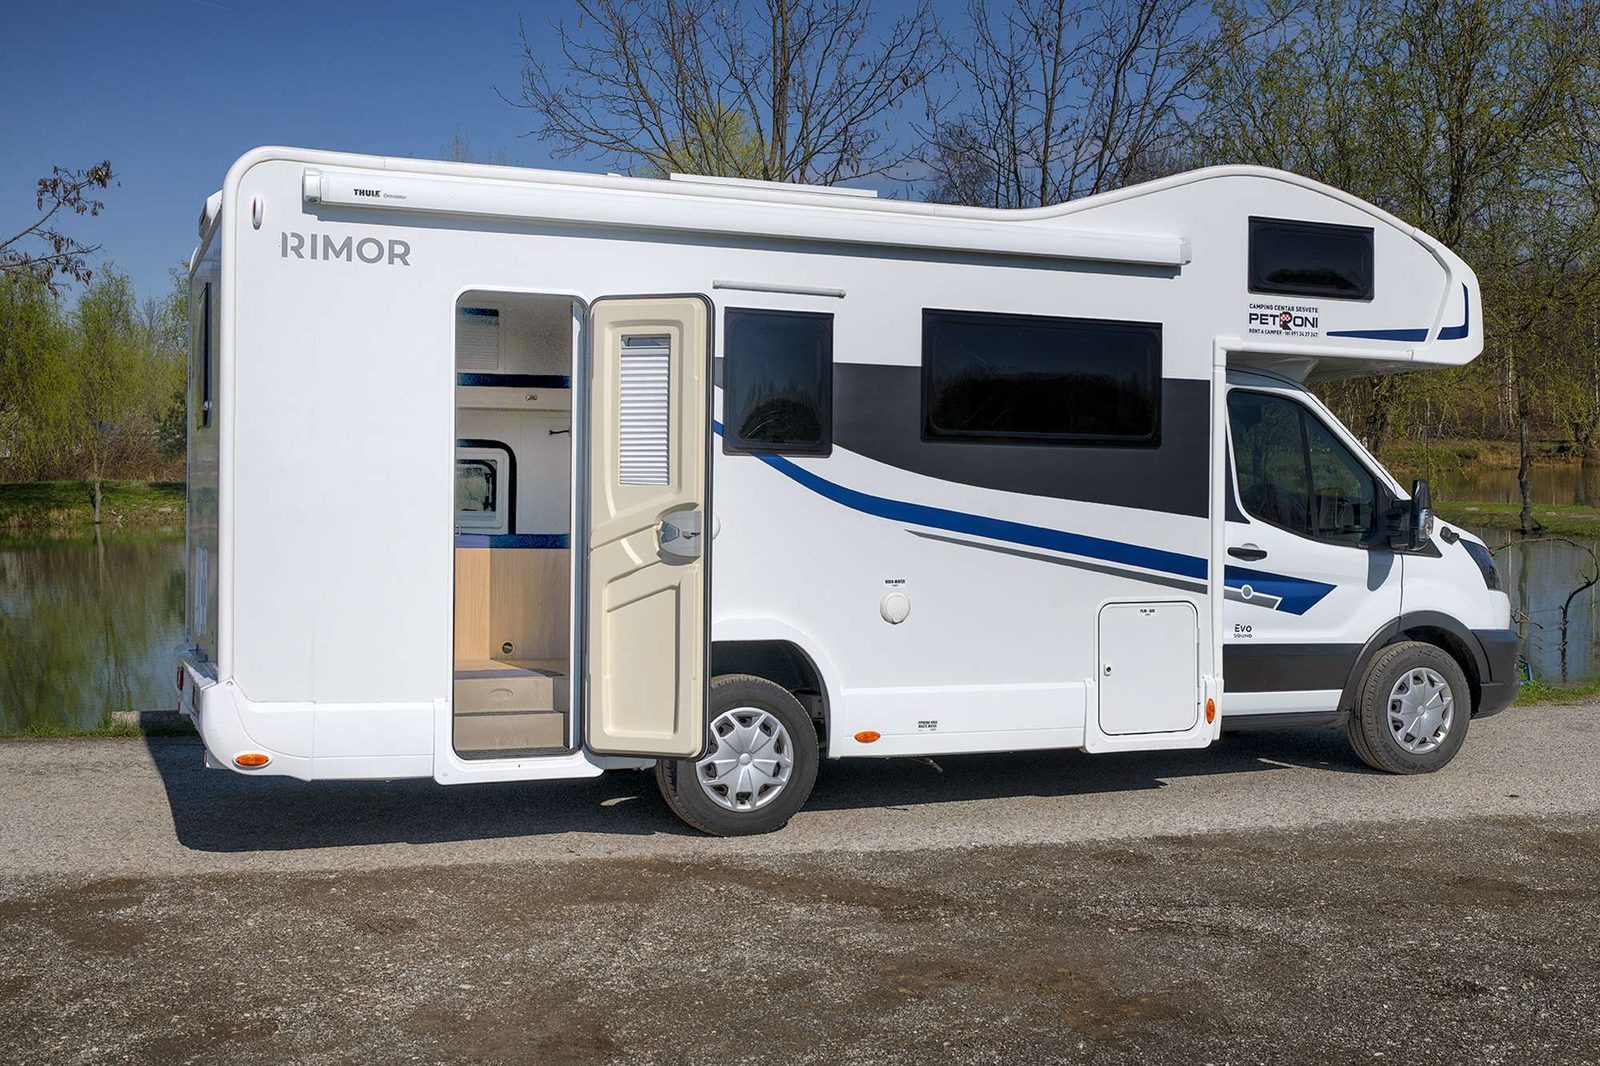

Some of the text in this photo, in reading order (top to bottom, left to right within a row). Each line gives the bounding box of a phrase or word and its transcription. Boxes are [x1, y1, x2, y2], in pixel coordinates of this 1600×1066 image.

[353, 188, 381, 198] THULE
[281, 231, 411, 266] RIMOR
[1249, 303, 1274, 311] CAMPING
[1274, 304, 1295, 312] CENTAR
[1248, 311, 1319, 331] PETRONI
[1234, 623, 1252, 633] EVO
